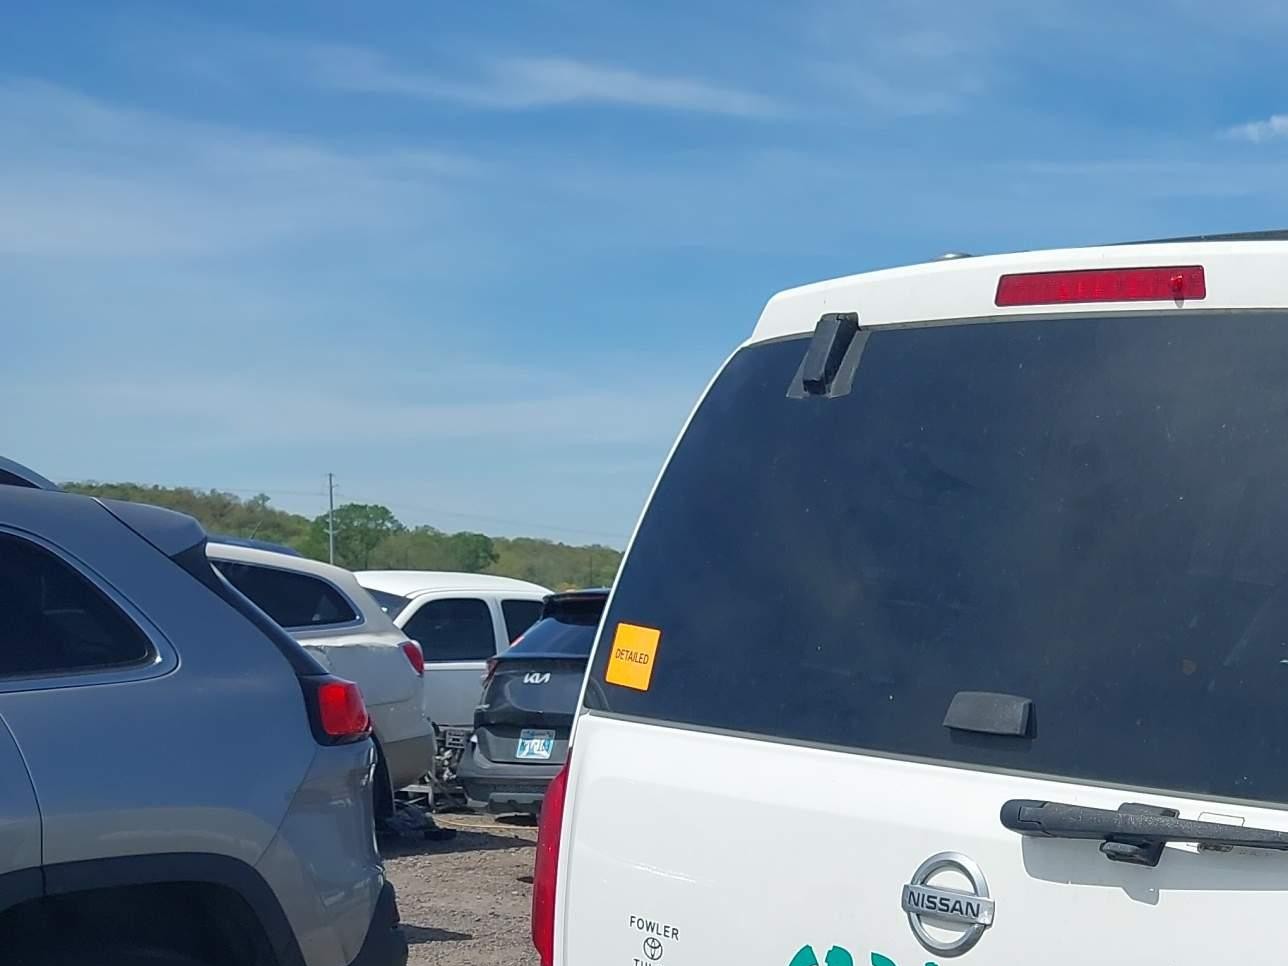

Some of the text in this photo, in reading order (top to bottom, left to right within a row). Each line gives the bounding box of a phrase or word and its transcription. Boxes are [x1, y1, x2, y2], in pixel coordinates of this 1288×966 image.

[614, 648, 649, 665] DETAILED
[523, 672, 551, 684] KIA
[907, 889, 981, 919] NISSAN
[629, 915, 680, 941] FOWLER
